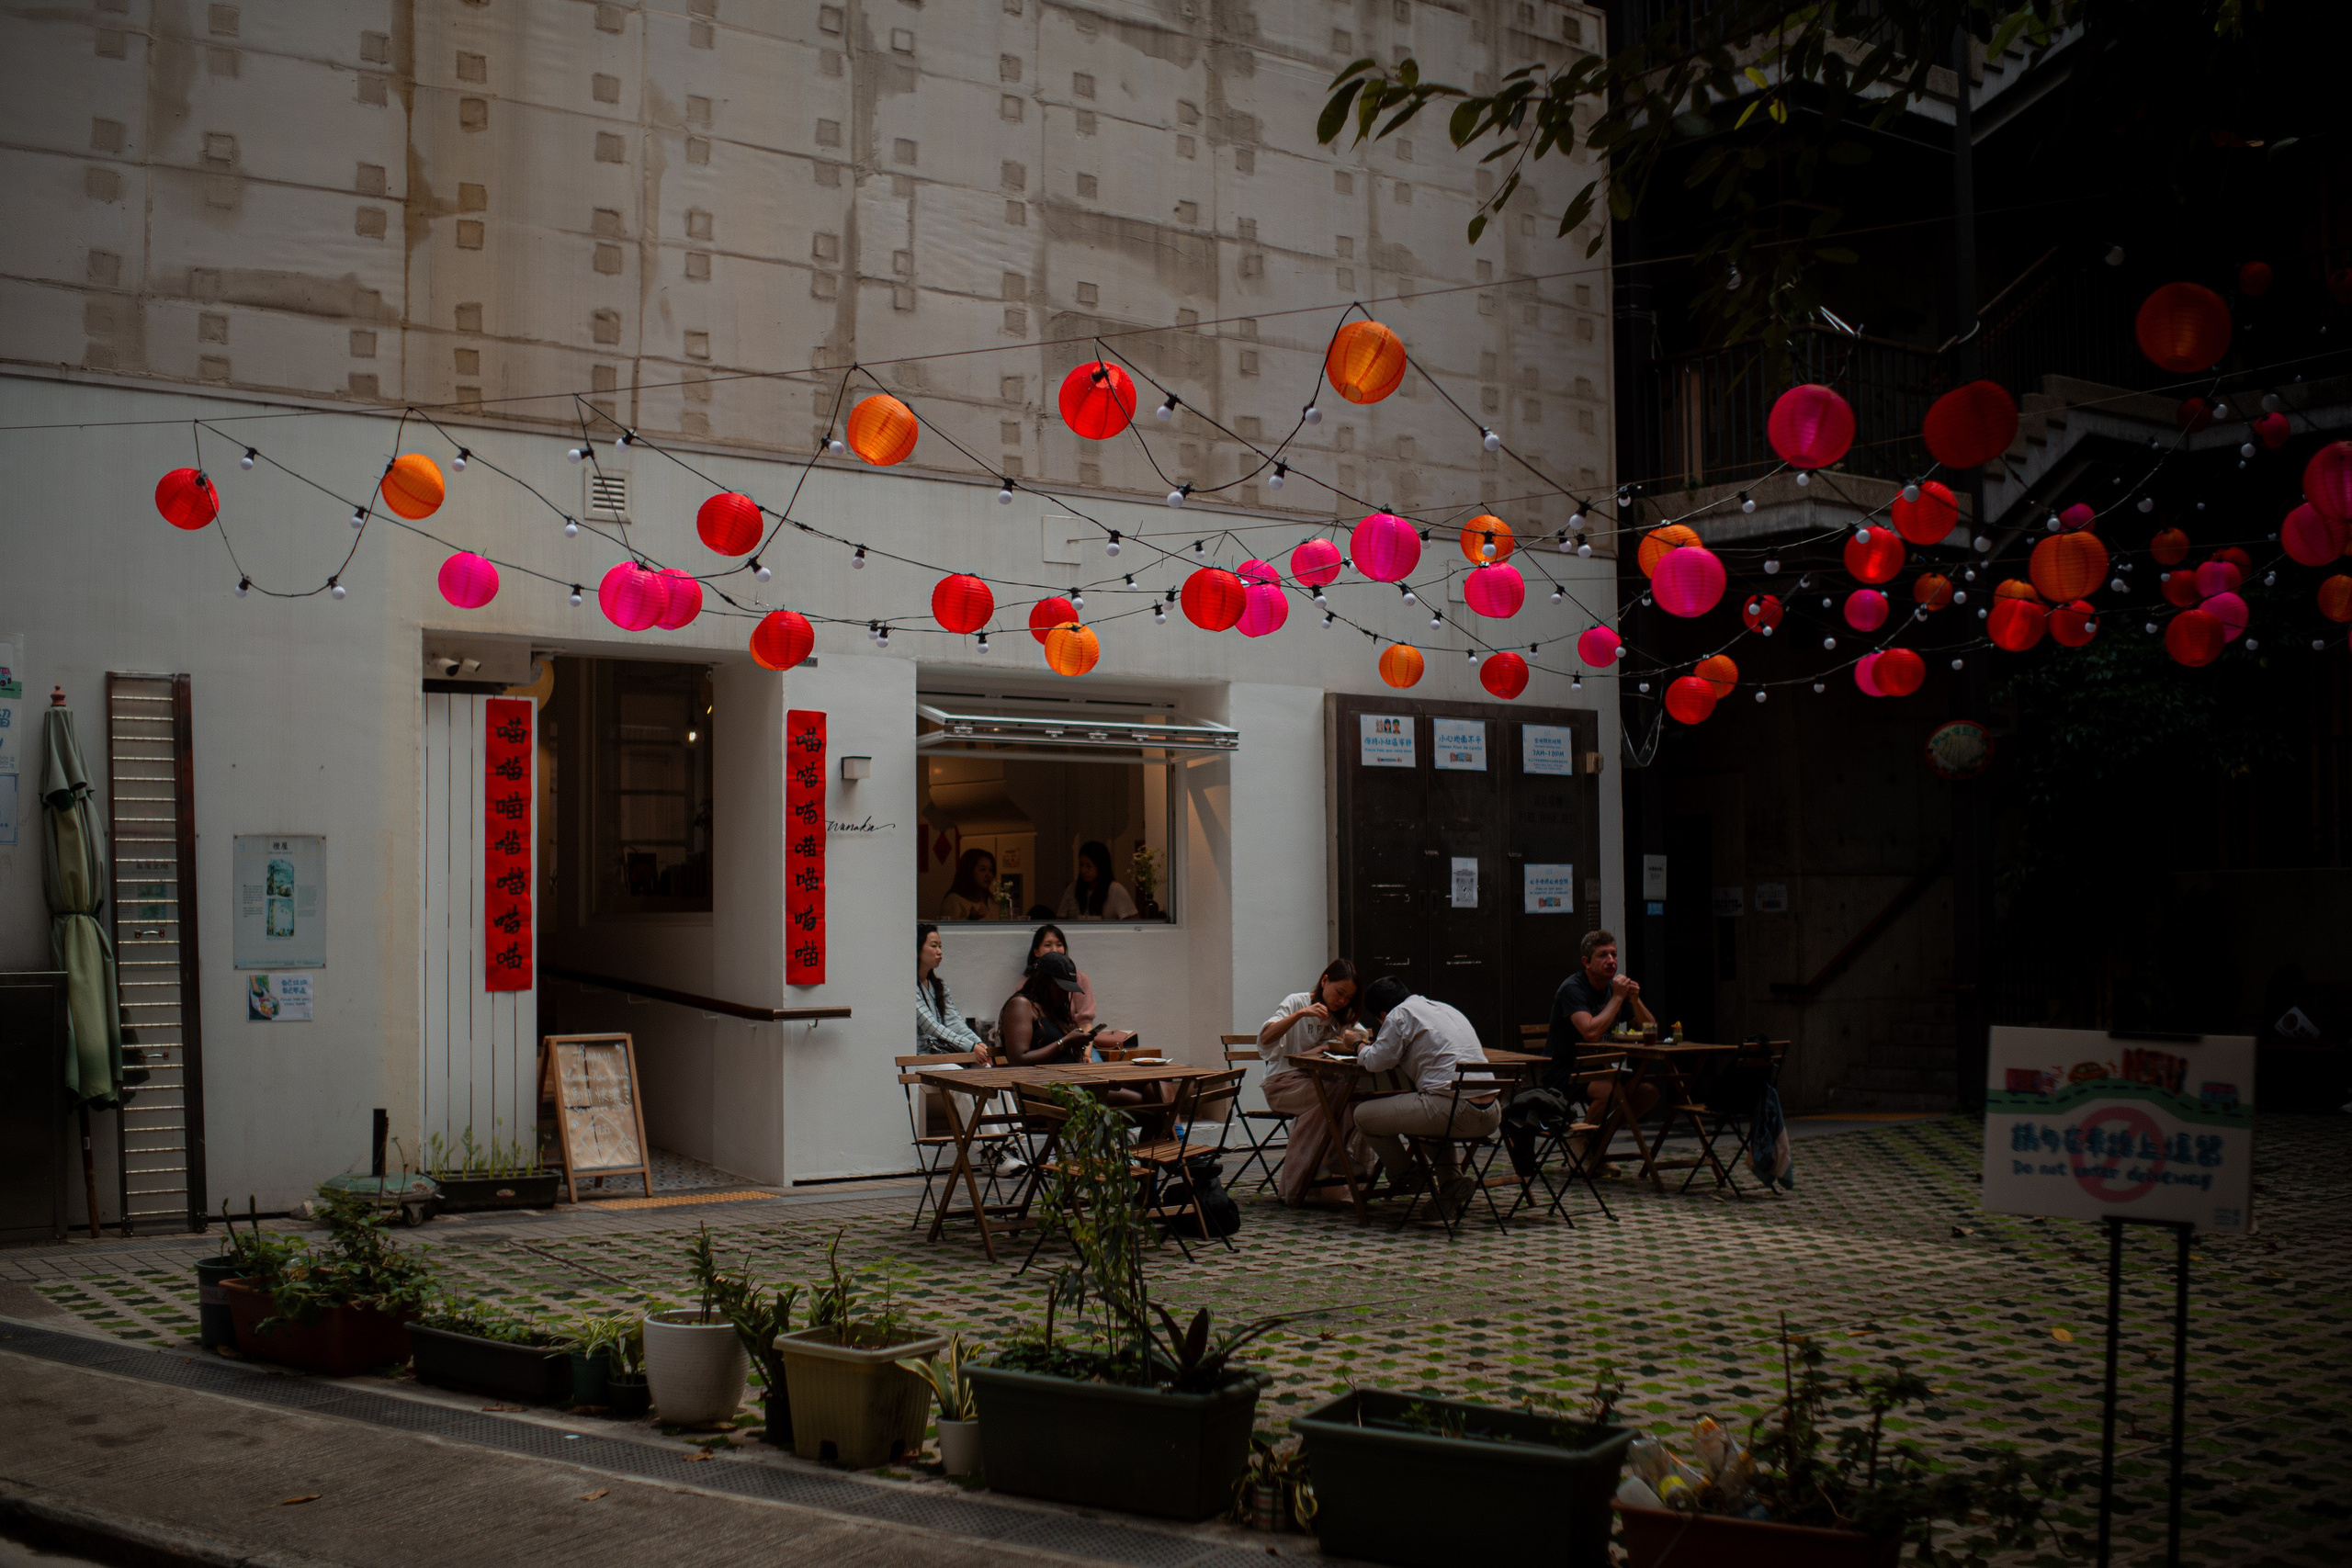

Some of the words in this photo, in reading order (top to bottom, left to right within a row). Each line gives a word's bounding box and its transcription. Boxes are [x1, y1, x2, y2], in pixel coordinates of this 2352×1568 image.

[1439, 734, 1482, 744] 小心地面不平
[493, 716, 526, 970] 喵喵喵喵喵喵喵
[795, 726, 821, 968] 喵喵喵喵喵喵喵
[2012, 1160, 2034, 1176] Do
[2040, 1162, 2067, 1176] not
[2127, 1166, 2213, 1191] driveway
